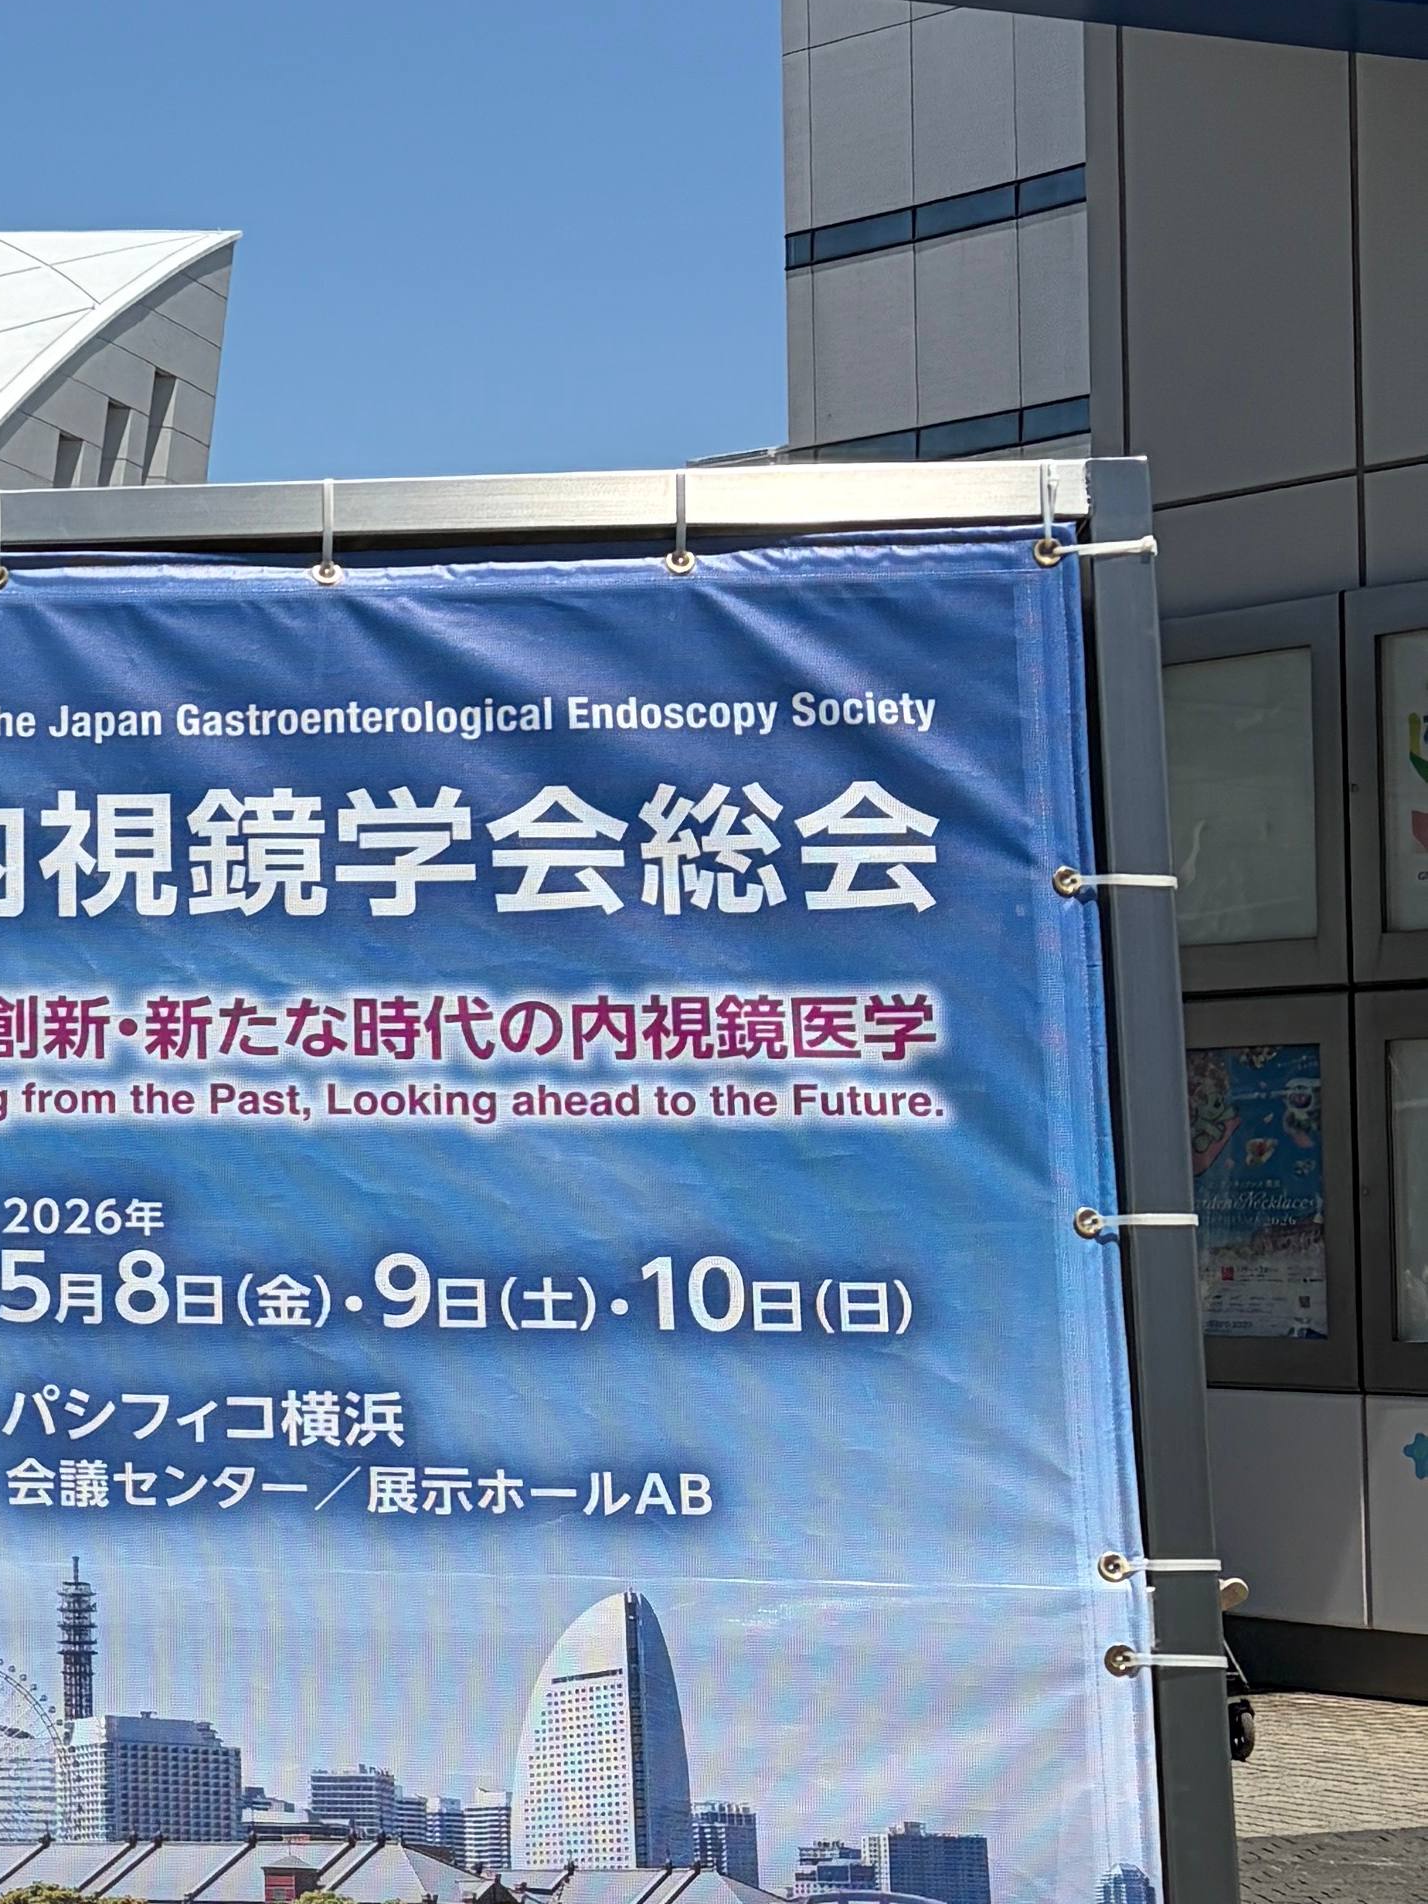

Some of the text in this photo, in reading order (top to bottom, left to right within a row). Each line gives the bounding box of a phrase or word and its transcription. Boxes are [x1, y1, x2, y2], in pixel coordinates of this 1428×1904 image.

[49, 702, 163, 743] Japan
[176, 698, 553, 741] Gastroenterological
[567, 696, 777, 734] Endoscopy
[790, 692, 936, 734] Society
[21, 1082, 117, 1117] from
[129, 1081, 196, 1117] the
[208, 1082, 311, 1123] Past,
[326, 1082, 501, 1125] Looking
[511, 1082, 643, 1119] ahead
[653, 1085, 697, 1119] to
[708, 1083, 778, 1119] the
[791, 1083, 947, 1120] Future.
[3, 1198, 164, 1237] 2026年
[2, 1385, 405, 1450] パシフィコ横浜
